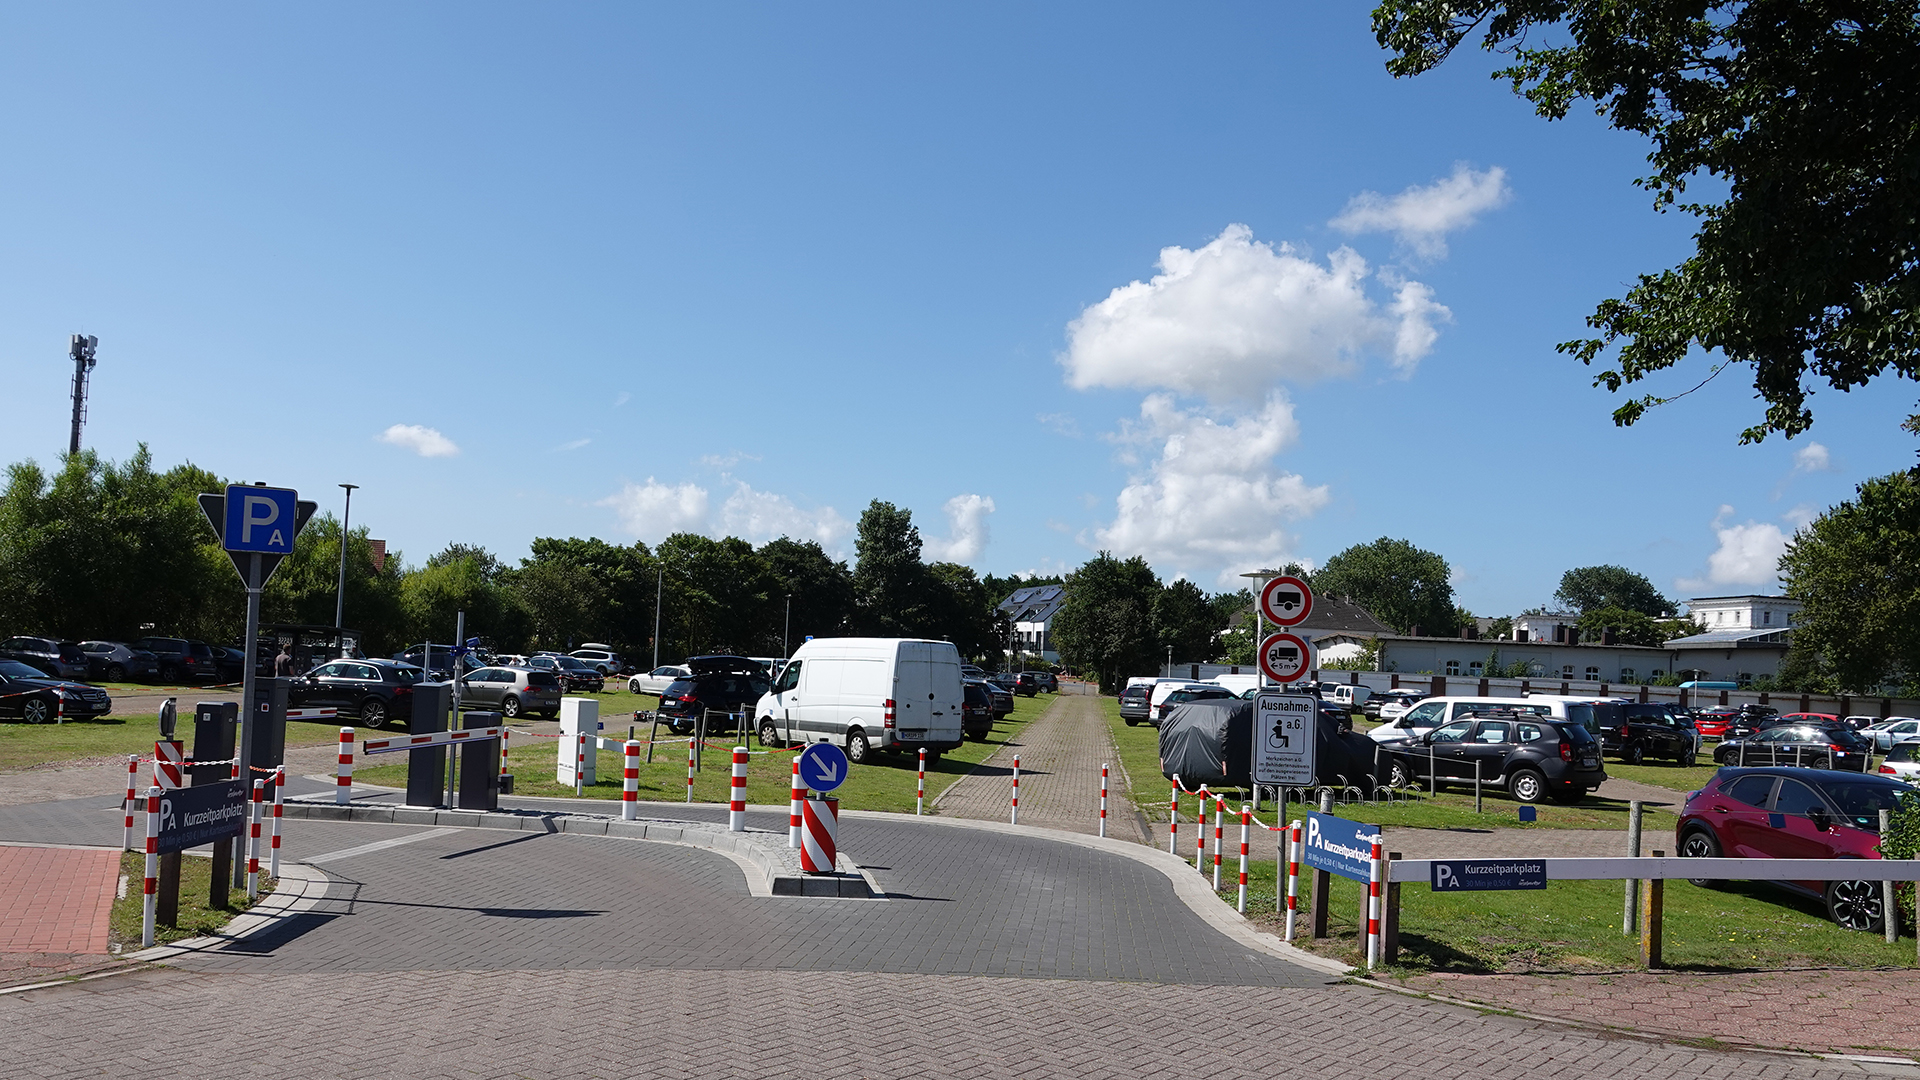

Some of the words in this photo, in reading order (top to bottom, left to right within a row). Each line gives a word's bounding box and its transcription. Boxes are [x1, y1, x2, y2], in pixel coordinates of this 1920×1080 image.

[1260, 699, 1312, 713] Ausnahme:
[1286, 719, 1303, 730] a.G.
[183, 803, 243, 827] Kurzzeitparkplatz
[1324, 839, 1372, 864] Kurzzeitparkplat
[1464, 863, 1541, 876] Kurzzeitparkplatz
